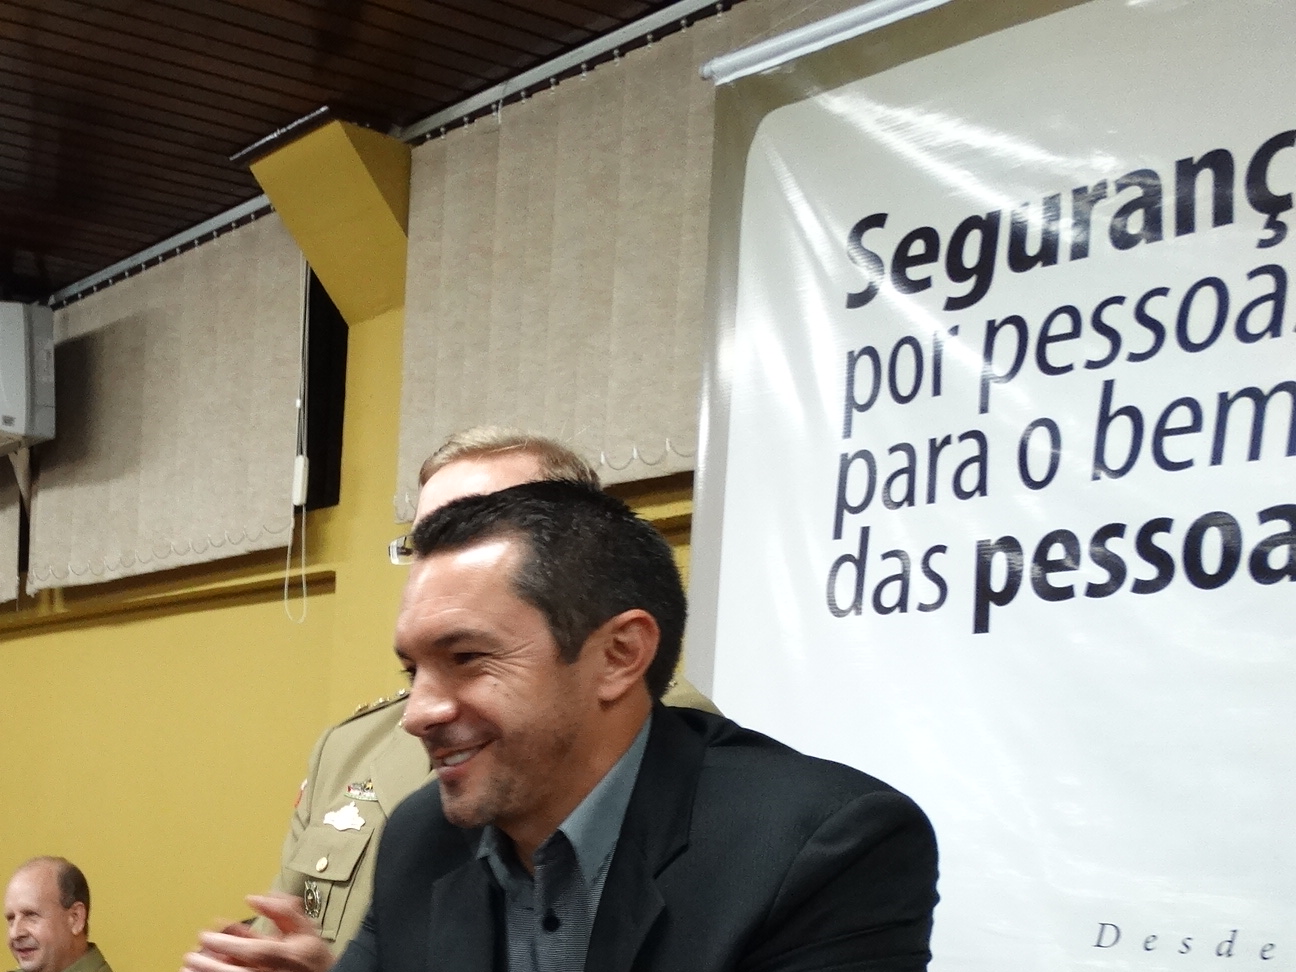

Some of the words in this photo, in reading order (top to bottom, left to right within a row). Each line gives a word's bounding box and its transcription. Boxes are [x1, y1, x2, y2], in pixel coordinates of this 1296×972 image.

[841, 323, 960, 438] por
[977, 262, 1296, 414] pessoa
[833, 428, 989, 540] para
[1017, 416, 1062, 491] o
[1091, 380, 1296, 482] bem
[826, 526, 949, 619] das
[1092, 922, 1277, 961] Desde
